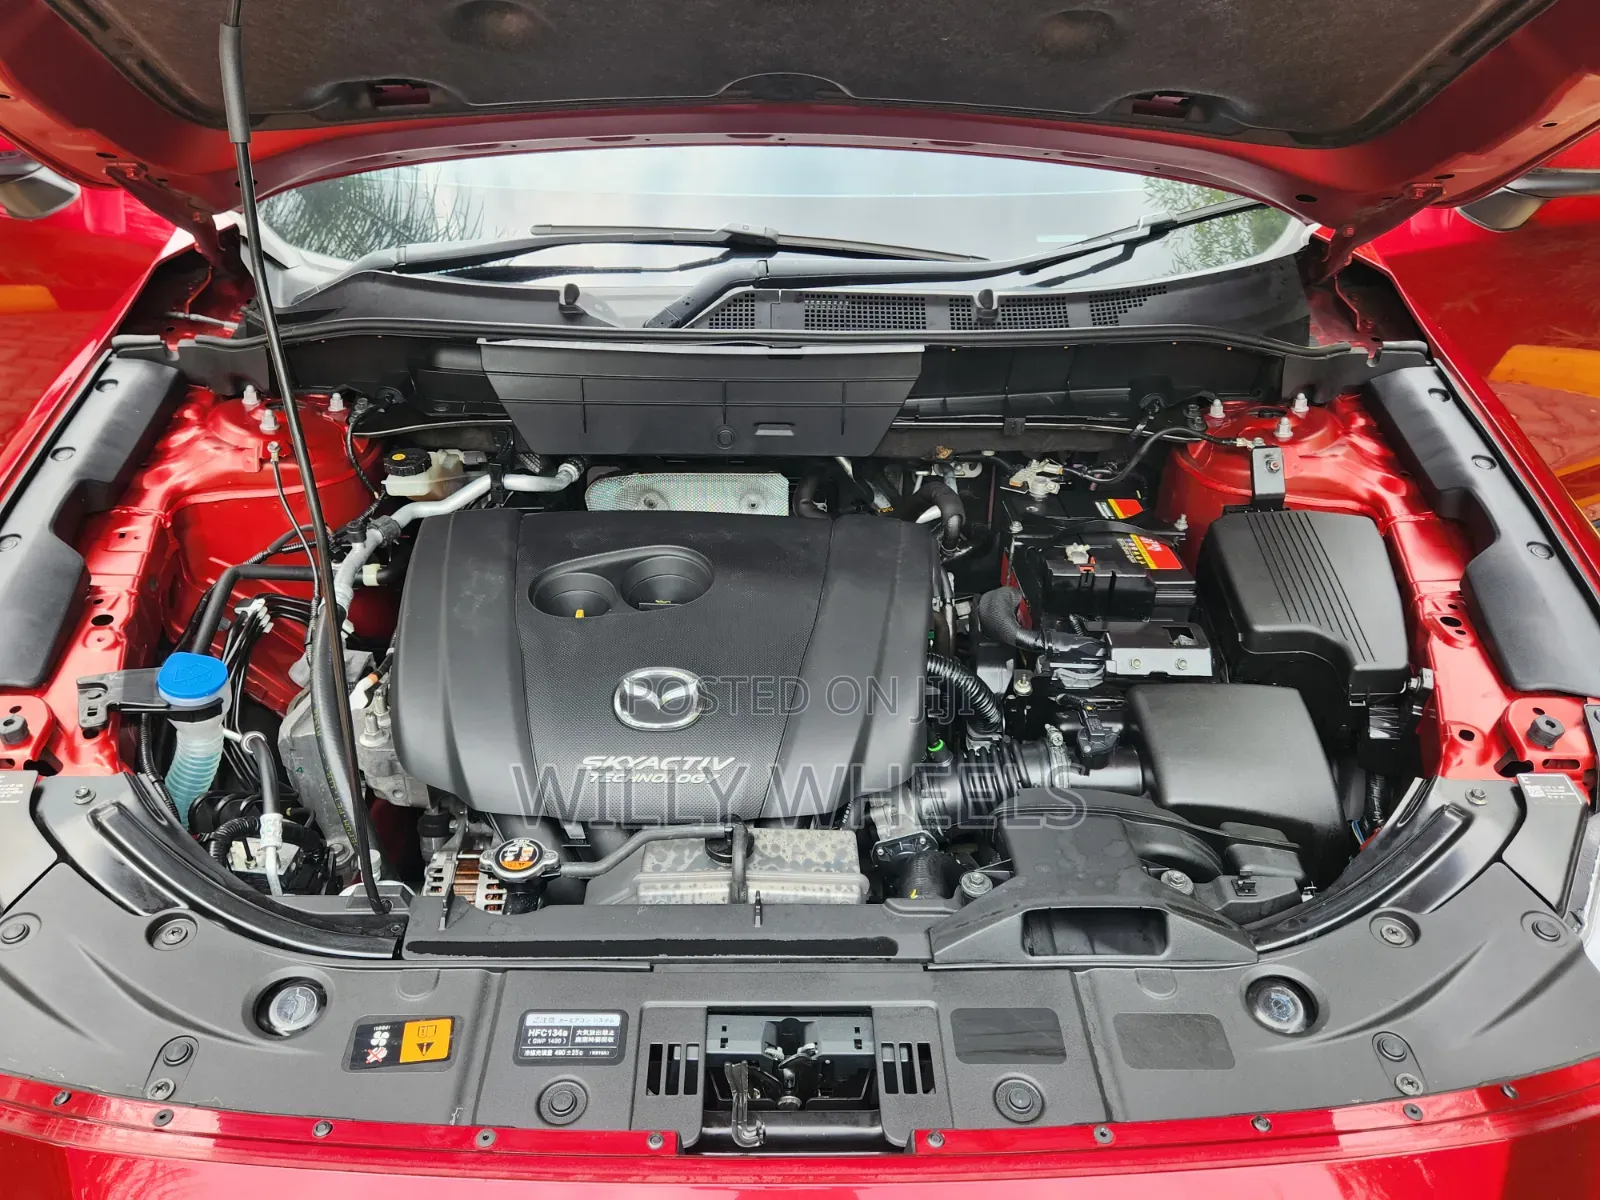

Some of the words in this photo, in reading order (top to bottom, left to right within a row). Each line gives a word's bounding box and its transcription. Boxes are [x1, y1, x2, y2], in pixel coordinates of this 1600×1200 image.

[582, 756, 736, 771] SKYACTIV
[589, 773, 721, 784] TECHNOLOGY
[528, 1028, 569, 1038] HFC134a
